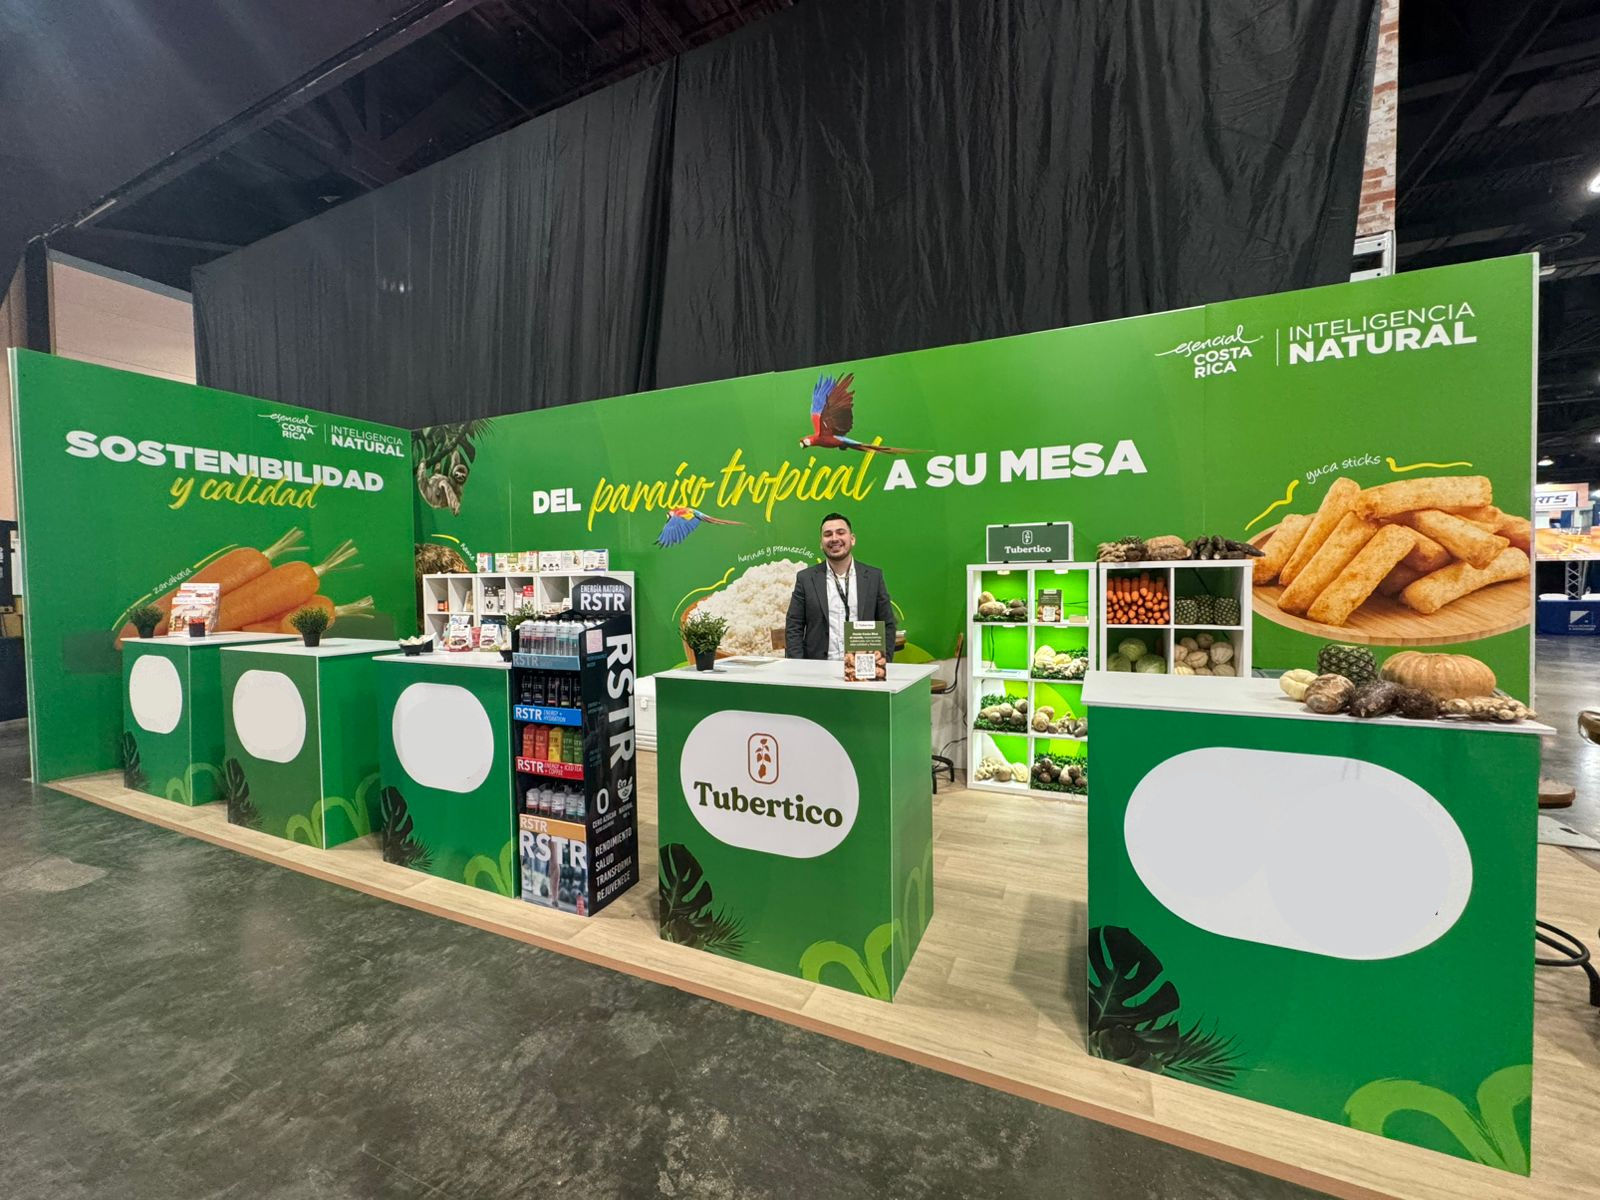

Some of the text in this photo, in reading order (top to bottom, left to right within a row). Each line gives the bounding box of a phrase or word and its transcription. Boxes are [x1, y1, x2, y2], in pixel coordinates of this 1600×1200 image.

[1289, 301, 1476, 342] INTELIGENCIA
[1154, 324, 1264, 358] esencial
[1289, 320, 1477, 365] NATURAL
[1193, 345, 1253, 366] COSTA
[1194, 360, 1238, 379] RICA
[282, 422, 314, 435] COSTA
[282, 431, 306, 441] RICA
[331, 425, 403, 445] INTELIGENCIA
[331, 434, 405, 457] NATURAL
[64, 430, 384, 492] SOSTENIBILIDAD
[1305, 452, 1381, 485] yuca sticks
[168, 470, 324, 509] y calidad
[532, 436, 1148, 532] DEL paraíso tropical A SU MESA
[737, 544, 815, 563] harinas y premezclas
[1004, 544, 1052, 554] Tubertico
[602, 584, 625, 593] NATURAL
[580, 592, 626, 611] RSTR
[512, 655, 539, 667] RSTR
[606, 633, 635, 769] RSTR
[515, 707, 542, 721] RSTR
[517, 759, 544, 773] RSTR
[596, 788, 610, 815] 0
[693, 781, 844, 828] Tubertico
[520, 817, 548, 832] RSTR
[519, 829, 587, 869] RSTR
[595, 826, 633, 857] RENDIMIENTO
[595, 852, 615, 872] SALUD
[596, 855, 632, 887] TRANSFORMA
